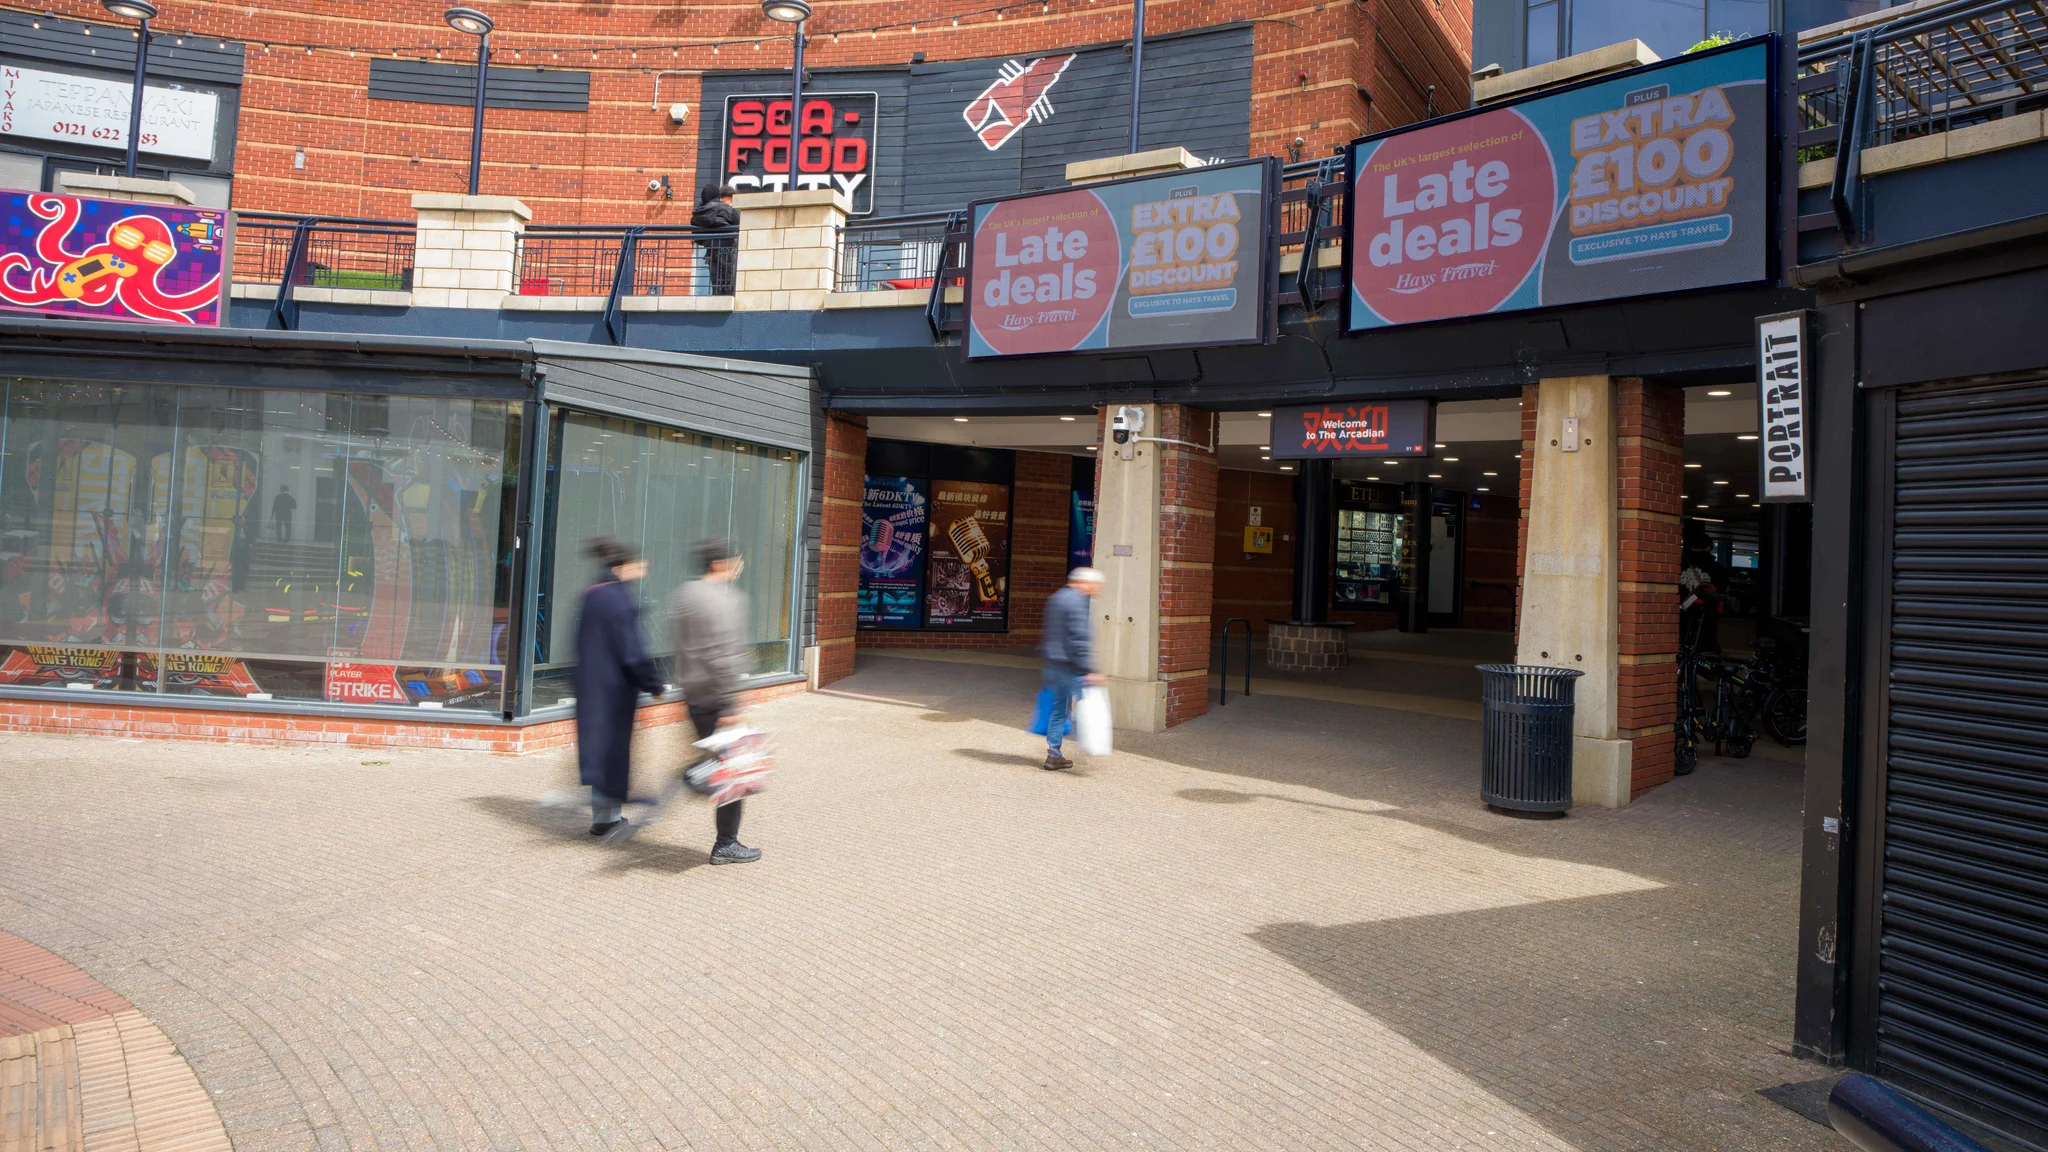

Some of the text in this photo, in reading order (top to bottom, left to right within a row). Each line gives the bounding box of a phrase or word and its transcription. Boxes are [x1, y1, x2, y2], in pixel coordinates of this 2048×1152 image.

[1, 69, 20, 132] MIYAKO
[27, 99, 100, 118] JAPANESE
[1634, 91, 1660, 103] PLUS
[53, 122, 86, 136] 0121
[92, 126, 120, 140] 622
[1574, 87, 1731, 152] EXTRA
[728, 137, 867, 173] FOOD
[1373, 163, 1390, 173] The
[1418, 147, 1455, 163] largest
[1458, 135, 1509, 153] selection
[1511, 130, 1524, 140] of
[1573, 127, 1729, 199] £100
[1175, 189, 1193, 197] PLUS
[1383, 159, 1510, 218] Late
[1573, 179, 1729, 227] DISCOUNT
[988, 222, 1002, 230] The
[1022, 215, 1050, 229] largest
[1051, 210, 1089, 225] selection
[1090, 208, 1099, 218] of
[1134, 192, 1238, 230] EXTRA
[996, 226, 1089, 267] Late
[1133, 222, 1237, 267] £100
[1369, 202, 1523, 267] deals
[1578, 223, 1722, 252] EXCLUSIVE TO HAYS TRAVEL
[983, 263, 1097, 307] deals
[1131, 262, 1235, 289] DISCOUNT
[1394, 260, 1499, 291] Hays Travel
[1134, 293, 1230, 308] EXCLUSIVE TO HAYS TRAVEL
[1003, 309, 1079, 329] Hays Travel
[1765, 334, 1802, 483] PORTRAIT
[1302, 404, 1389, 452] 欢迎
[1306, 428, 1384, 440] to The Arcadian
[1323, 420, 1368, 430] Welcome
[32, 653, 104, 668] KING KONG
[188, 661, 222, 673] KONG
[330, 670, 362, 678] PLAYER
[328, 681, 392, 699] STRIKE
